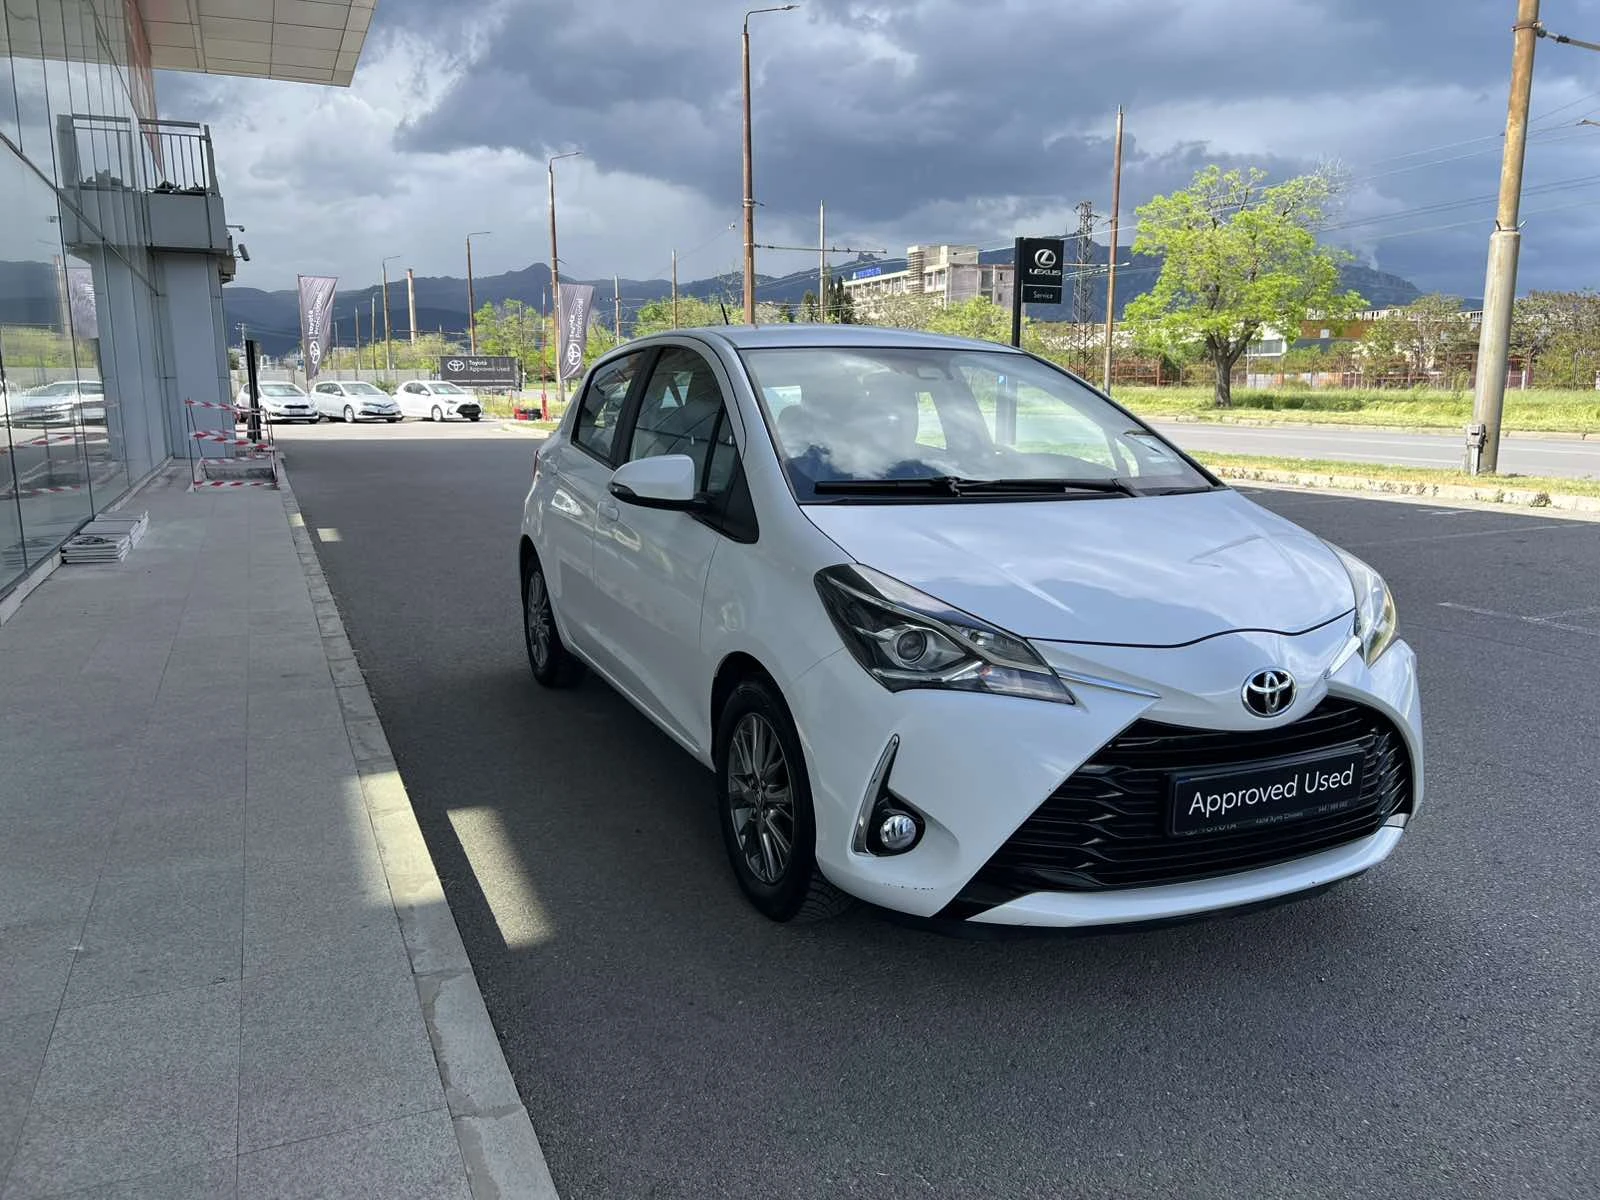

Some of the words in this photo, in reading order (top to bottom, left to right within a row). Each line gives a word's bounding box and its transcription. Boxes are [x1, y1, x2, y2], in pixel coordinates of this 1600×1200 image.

[1033, 291, 1053, 299] Service
[575, 299, 584, 338] Professional
[469, 359, 487, 367] Toyota
[1188, 774, 1298, 818] Approved
[1304, 763, 1354, 793] Used
